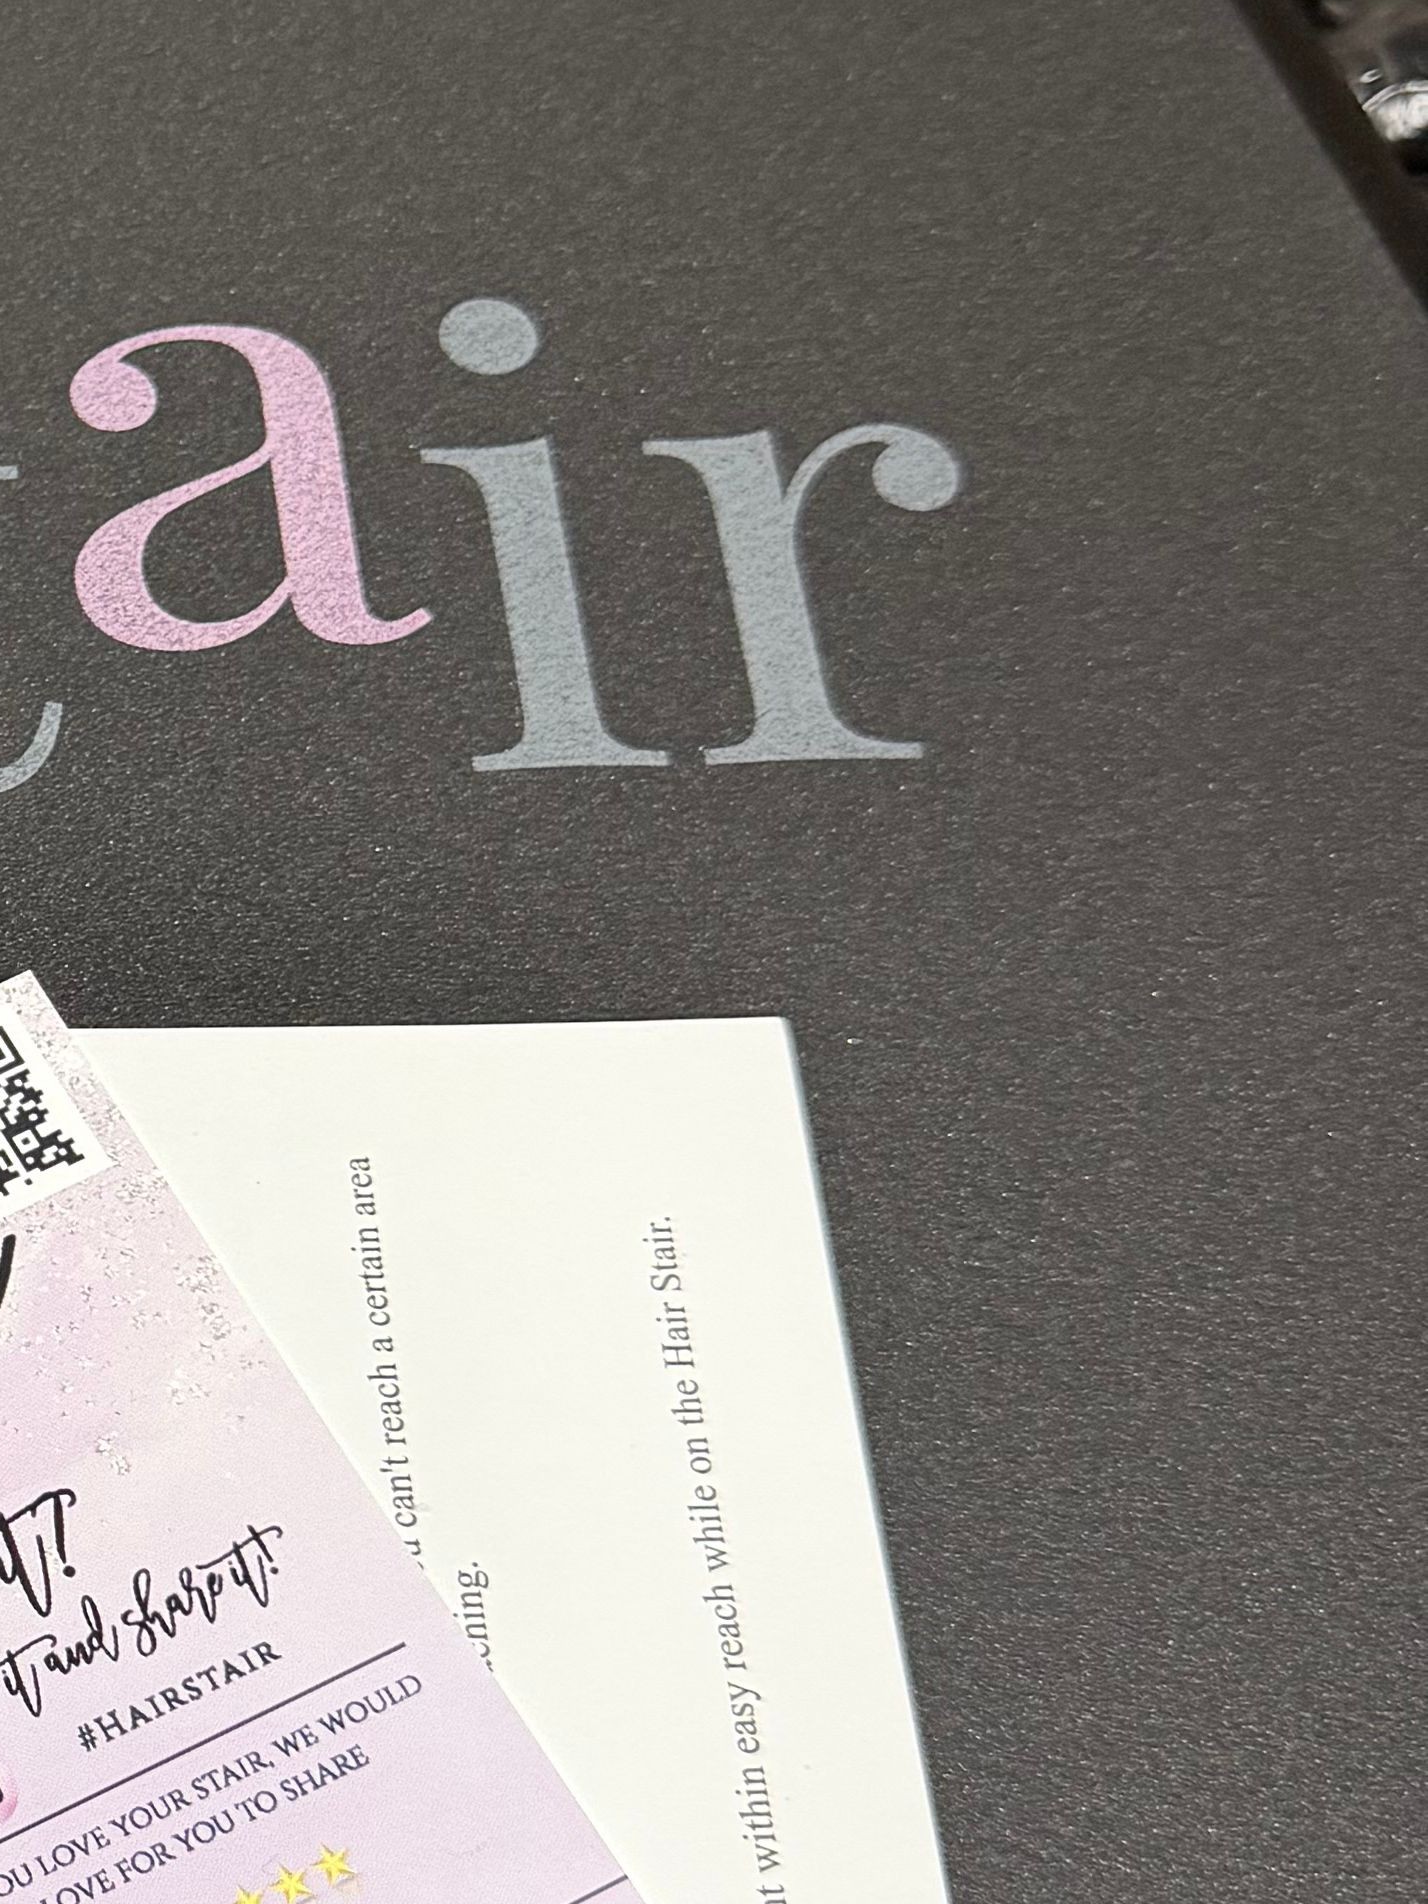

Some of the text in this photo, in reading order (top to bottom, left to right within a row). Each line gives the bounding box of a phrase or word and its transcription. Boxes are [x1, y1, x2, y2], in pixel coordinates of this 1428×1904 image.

[349, 1156, 377, 1216] area
[350, 1226, 391, 1327] certain
[642, 1216, 683, 1292] Stair.
[372, 1335, 395, 1353] a
[655, 1301, 696, 1369] Hair
[366, 1363, 407, 1446] reach
[670, 1379, 705, 1426] the
[379, 1456, 418, 1528] can't
[686, 1437, 713, 1475] on
[686, 1484, 730, 1573] while
[44, 1594, 120, 1675] and
[120, 1565, 224, 1657] share
[196, 1524, 283, 1608] it!
[452, 1561, 494, 1673] ning.
[701, 1584, 748, 1671] reach
[77, 1640, 282, 1752] #HAIRSTAIR
[727, 1681, 762, 1754] easy
[35, 1826, 112, 1877] LOVE
[110, 1788, 192, 1838] YOUR
[190, 1749, 275, 1801] STAIR,
[272, 1724, 321, 1759] WE
[318, 1673, 424, 1735] WOULD
[115, 1841, 177, 1886] FOR
[172, 1809, 237, 1854] YOU
[234, 1789, 279, 1824] TO
[280, 1744, 371, 1803] SHARE
[734, 1765, 781, 1874] within
